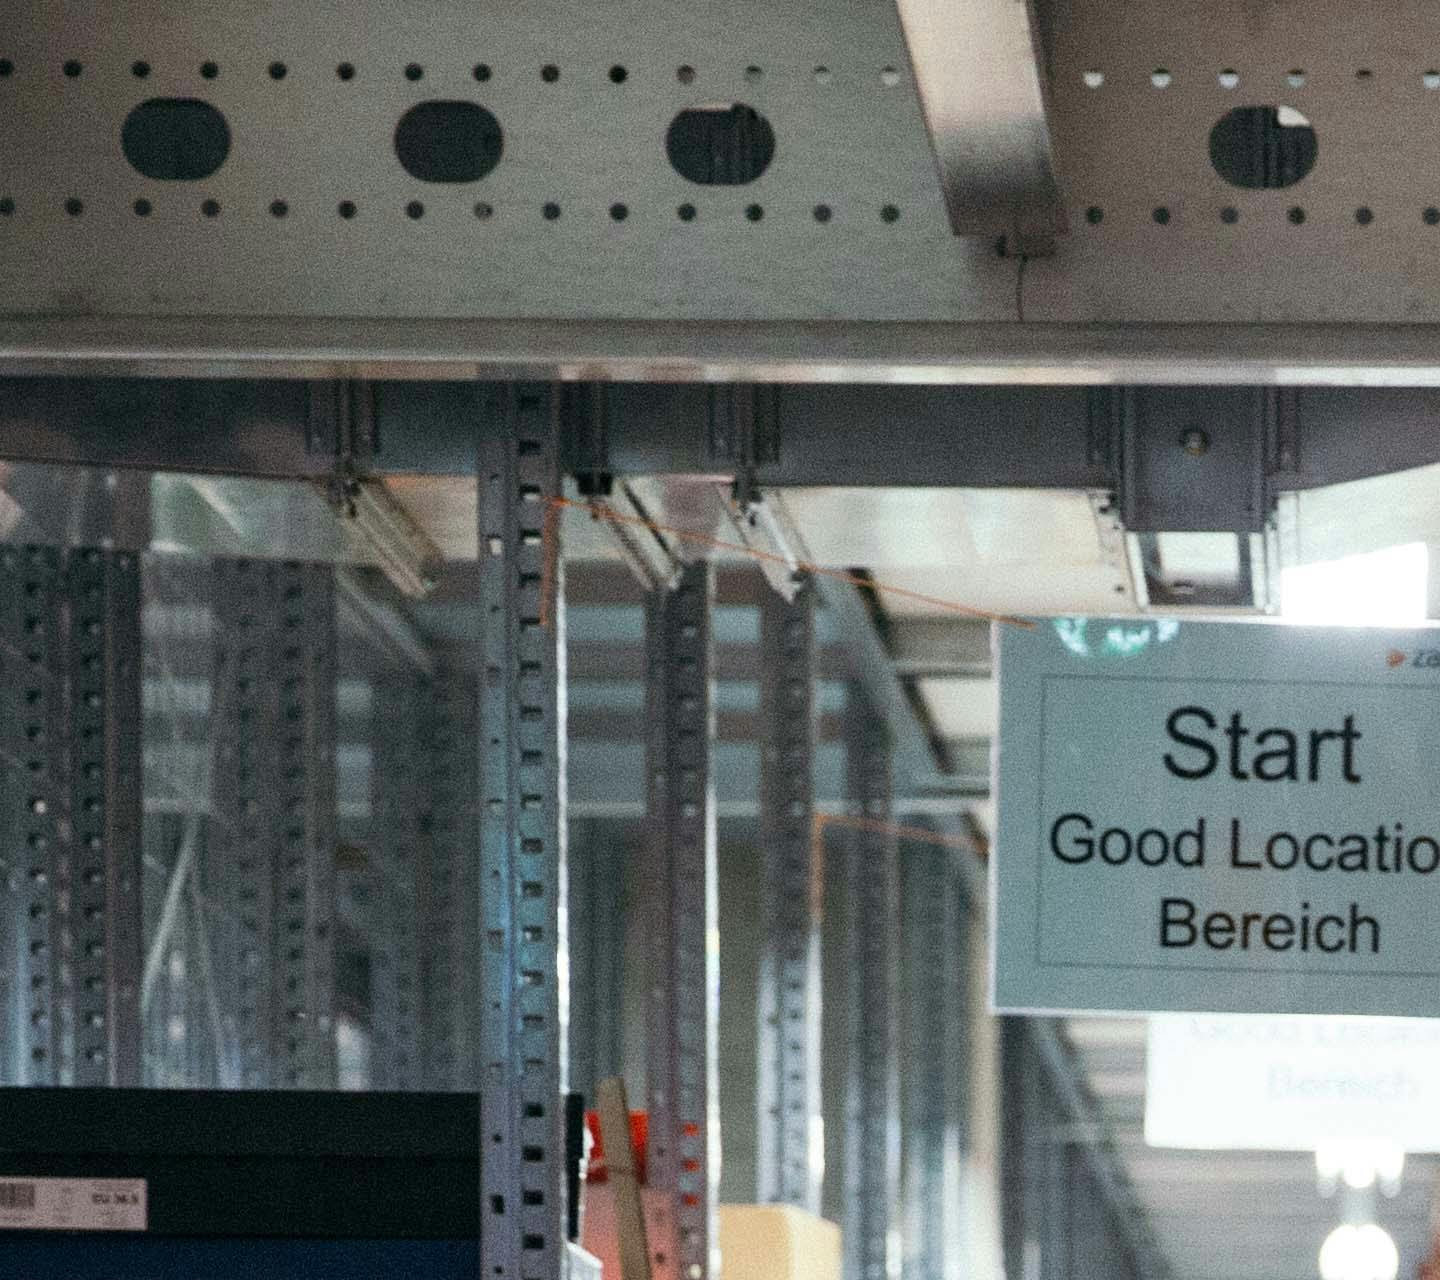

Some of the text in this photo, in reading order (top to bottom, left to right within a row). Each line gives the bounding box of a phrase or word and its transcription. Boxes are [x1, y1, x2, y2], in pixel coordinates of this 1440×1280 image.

[1163, 705, 1362, 784] Start
[1048, 811, 1207, 868] Good
[1159, 898, 1381, 954] Bereich
